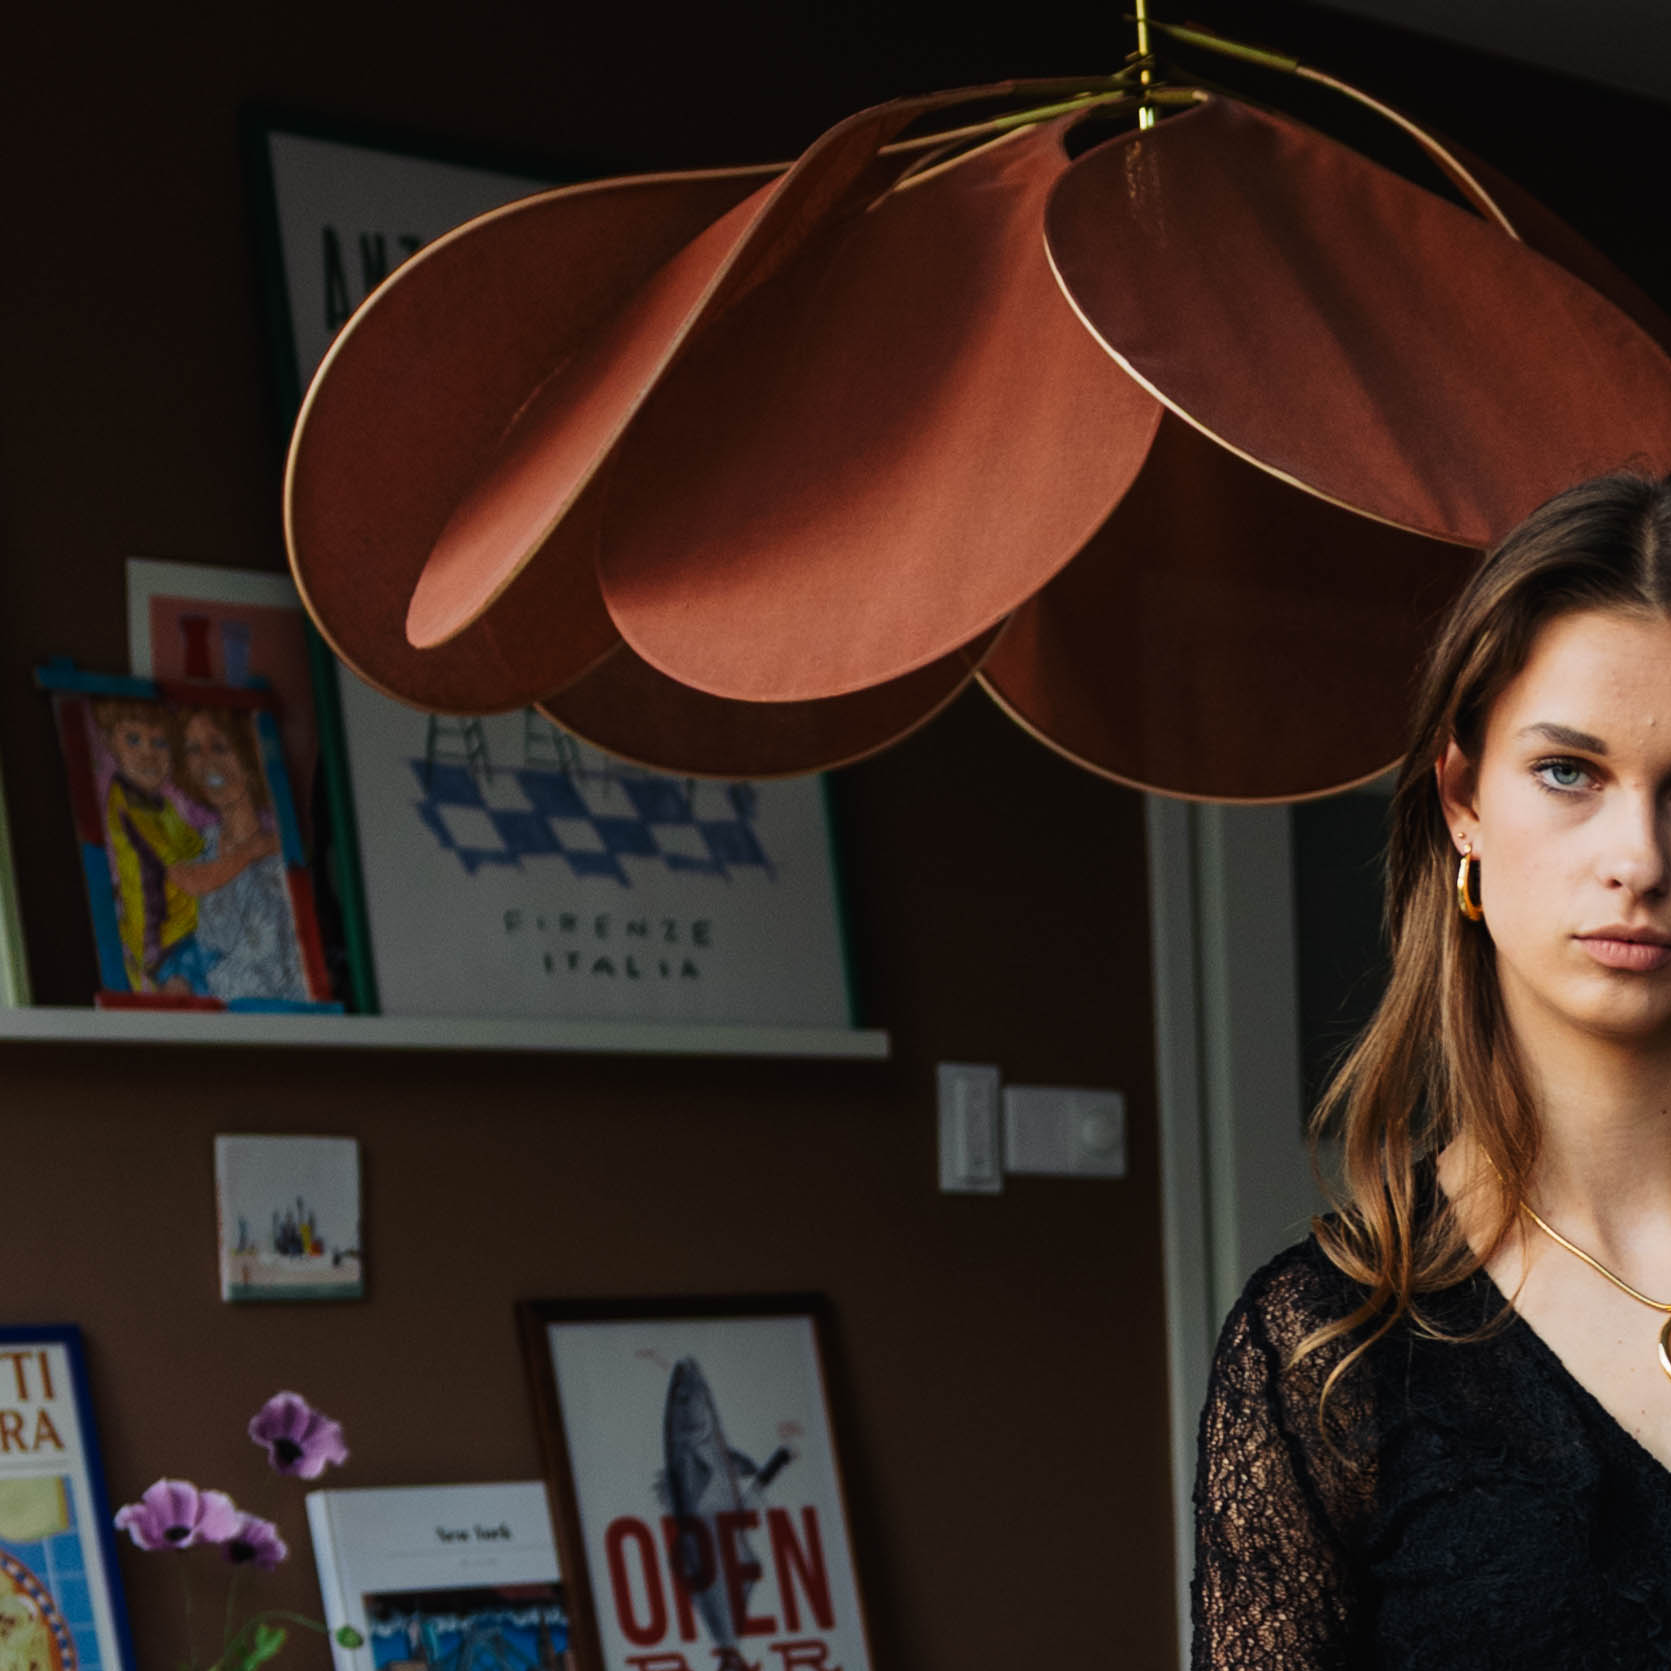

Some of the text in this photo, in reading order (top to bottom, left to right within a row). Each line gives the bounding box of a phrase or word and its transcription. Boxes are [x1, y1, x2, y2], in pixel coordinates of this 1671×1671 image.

[503, 909, 713, 946] FIRENZE
[543, 951, 699, 980] ITALIA
[605, 1505, 836, 1646] OPEN
